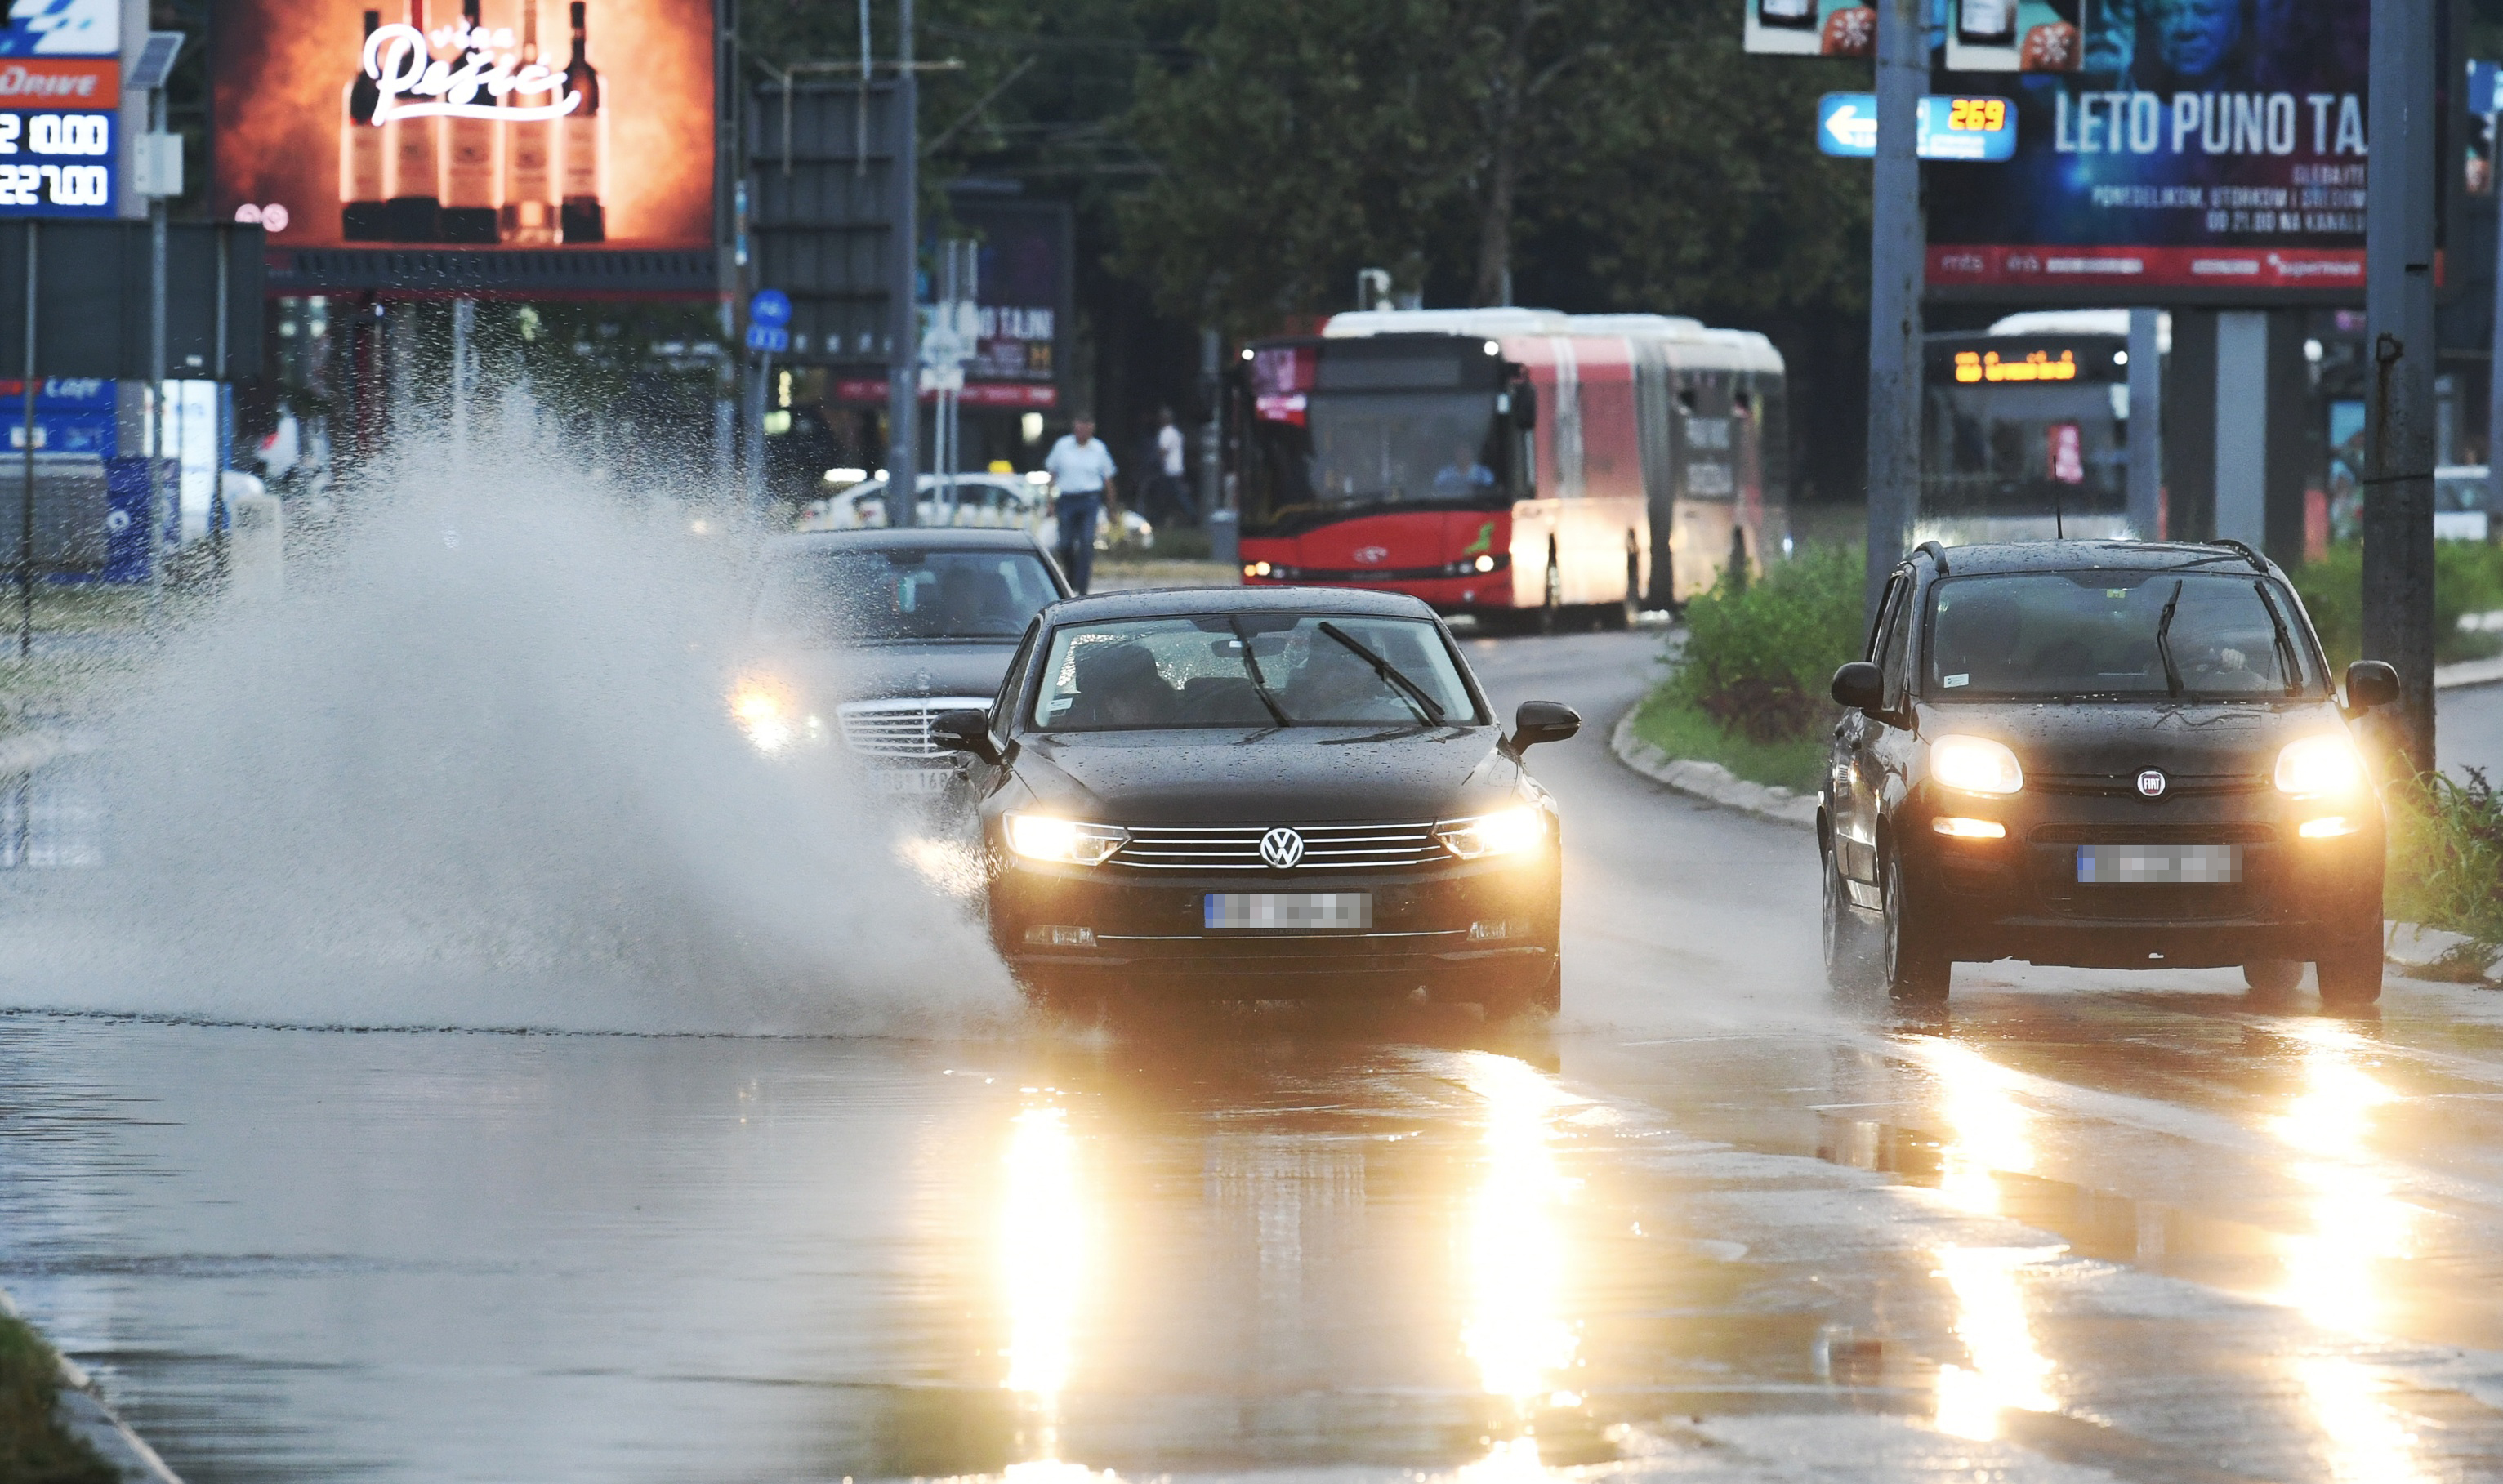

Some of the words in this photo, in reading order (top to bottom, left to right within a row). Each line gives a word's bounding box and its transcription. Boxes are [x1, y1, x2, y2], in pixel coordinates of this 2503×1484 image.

[1948, 100, 2006, 131] 269
[2055, 91, 2159, 153] LETO
[2171, 91, 2296, 154] PUNO
[2307, 93, 2369, 155] TA
[2144, 778, 2160, 790] FIAT
